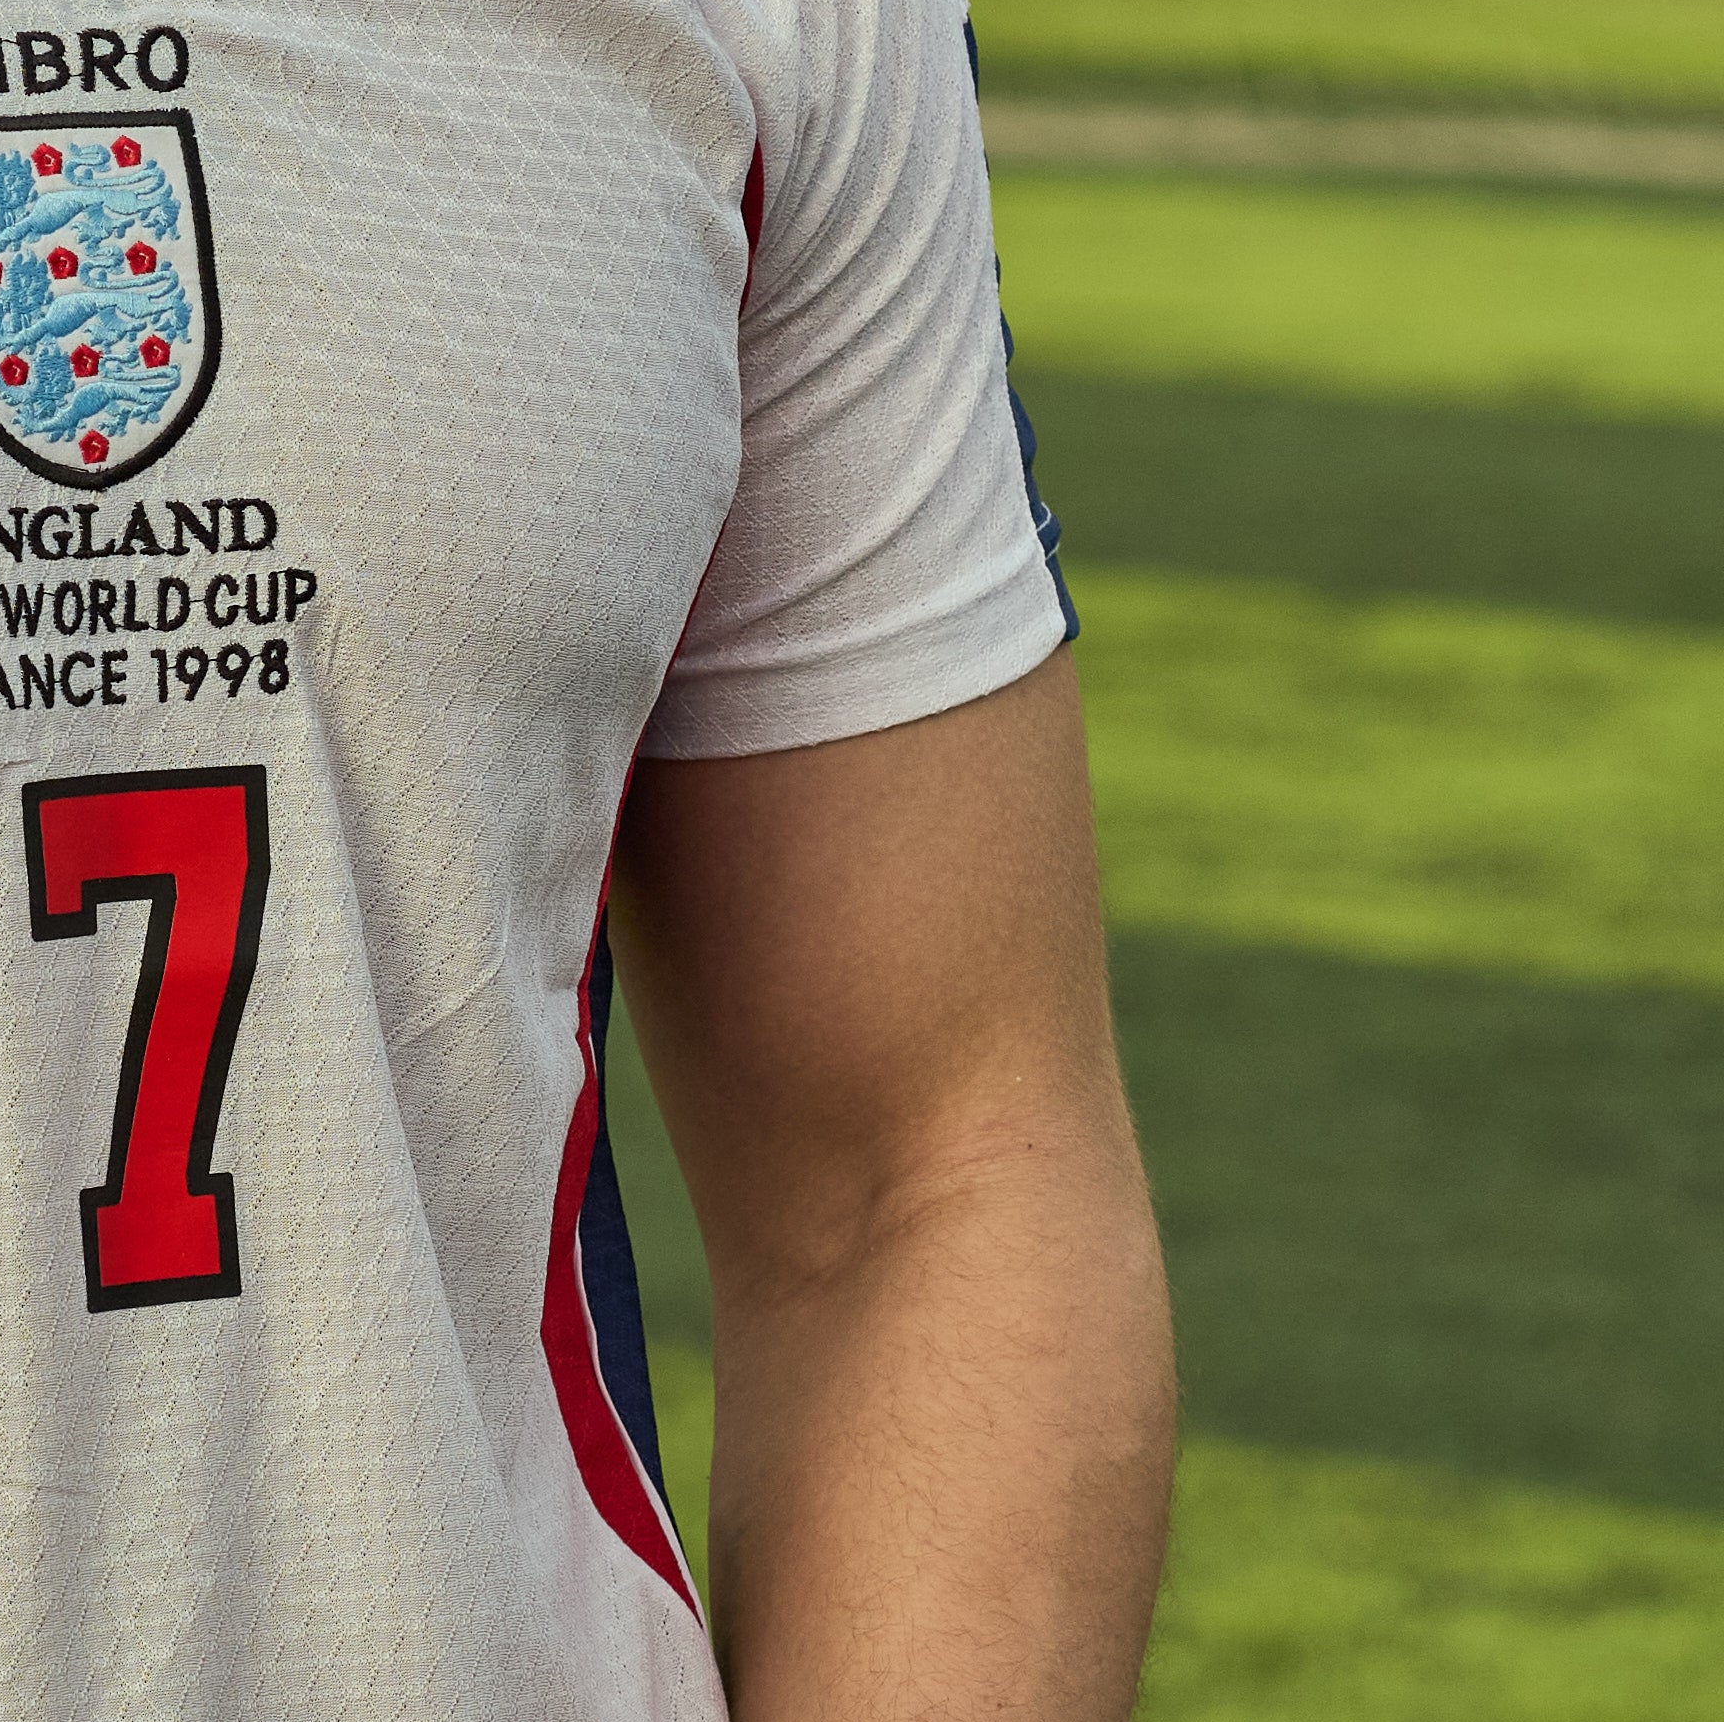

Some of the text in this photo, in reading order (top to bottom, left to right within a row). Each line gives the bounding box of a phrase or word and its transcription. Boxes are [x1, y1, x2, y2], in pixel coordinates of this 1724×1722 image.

[0, 575, 191, 639] WORLD
[205, 568, 317, 628] CUP
[152, 638, 290, 704] 1998
[22, 764, 271, 1314] 7
